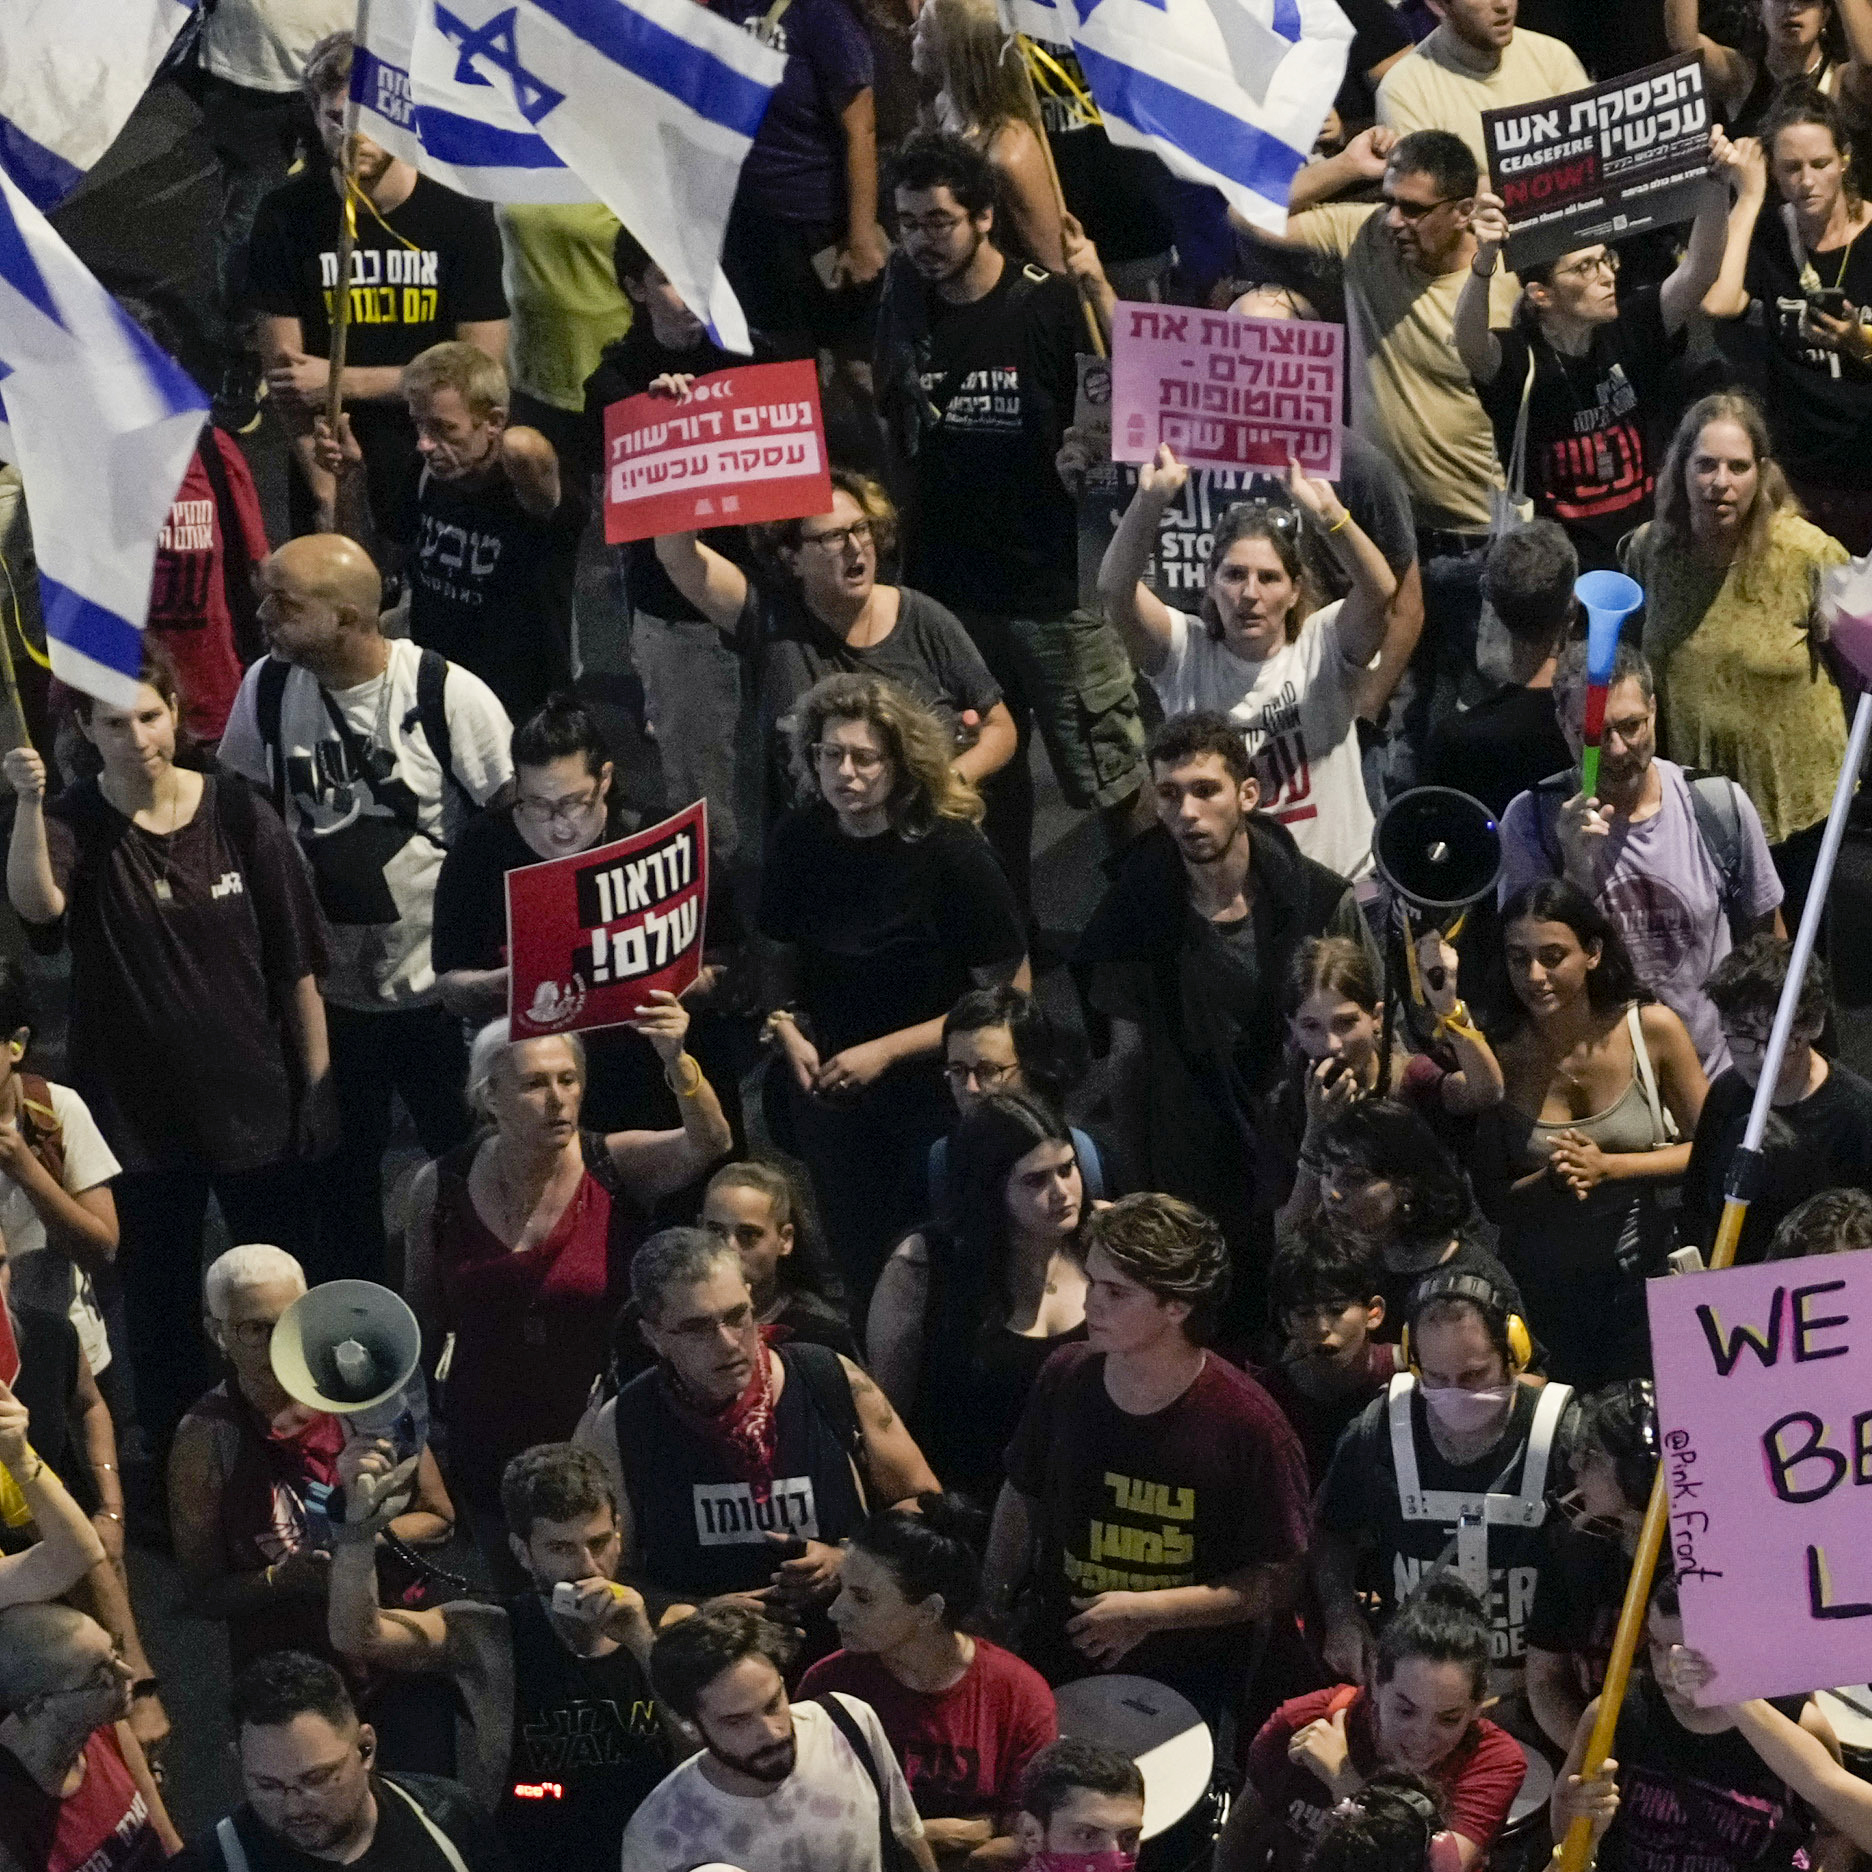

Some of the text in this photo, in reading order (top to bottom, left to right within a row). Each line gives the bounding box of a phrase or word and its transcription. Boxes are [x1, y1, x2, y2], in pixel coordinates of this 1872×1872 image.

[1494, 62, 1702, 151] הפסקת אש
[1600, 98, 1707, 158] עכשיו
[1499, 135, 1594, 174] CEASEFIRE
[1503, 155, 1595, 206] NOW!
[319, 249, 438, 287] אתם בבת
[403, 287, 438, 324] הם
[1129, 311, 1335, 358] עוצרות את
[1208, 353, 1334, 392] העולם
[1159, 378, 1333, 424] החטופות
[611, 400, 814, 460] נשים דורשות
[1162, 418, 1329, 460] עדיין שם
[620, 443, 806, 491] עסקה עכשיו!
[1161, 531, 1216, 560] STO
[1161, 561, 1208, 588] TH
[594, 832, 692, 924] לדראון
[590, 894, 698, 983] עולם!
[1695, 1279, 1851, 1378] WE
